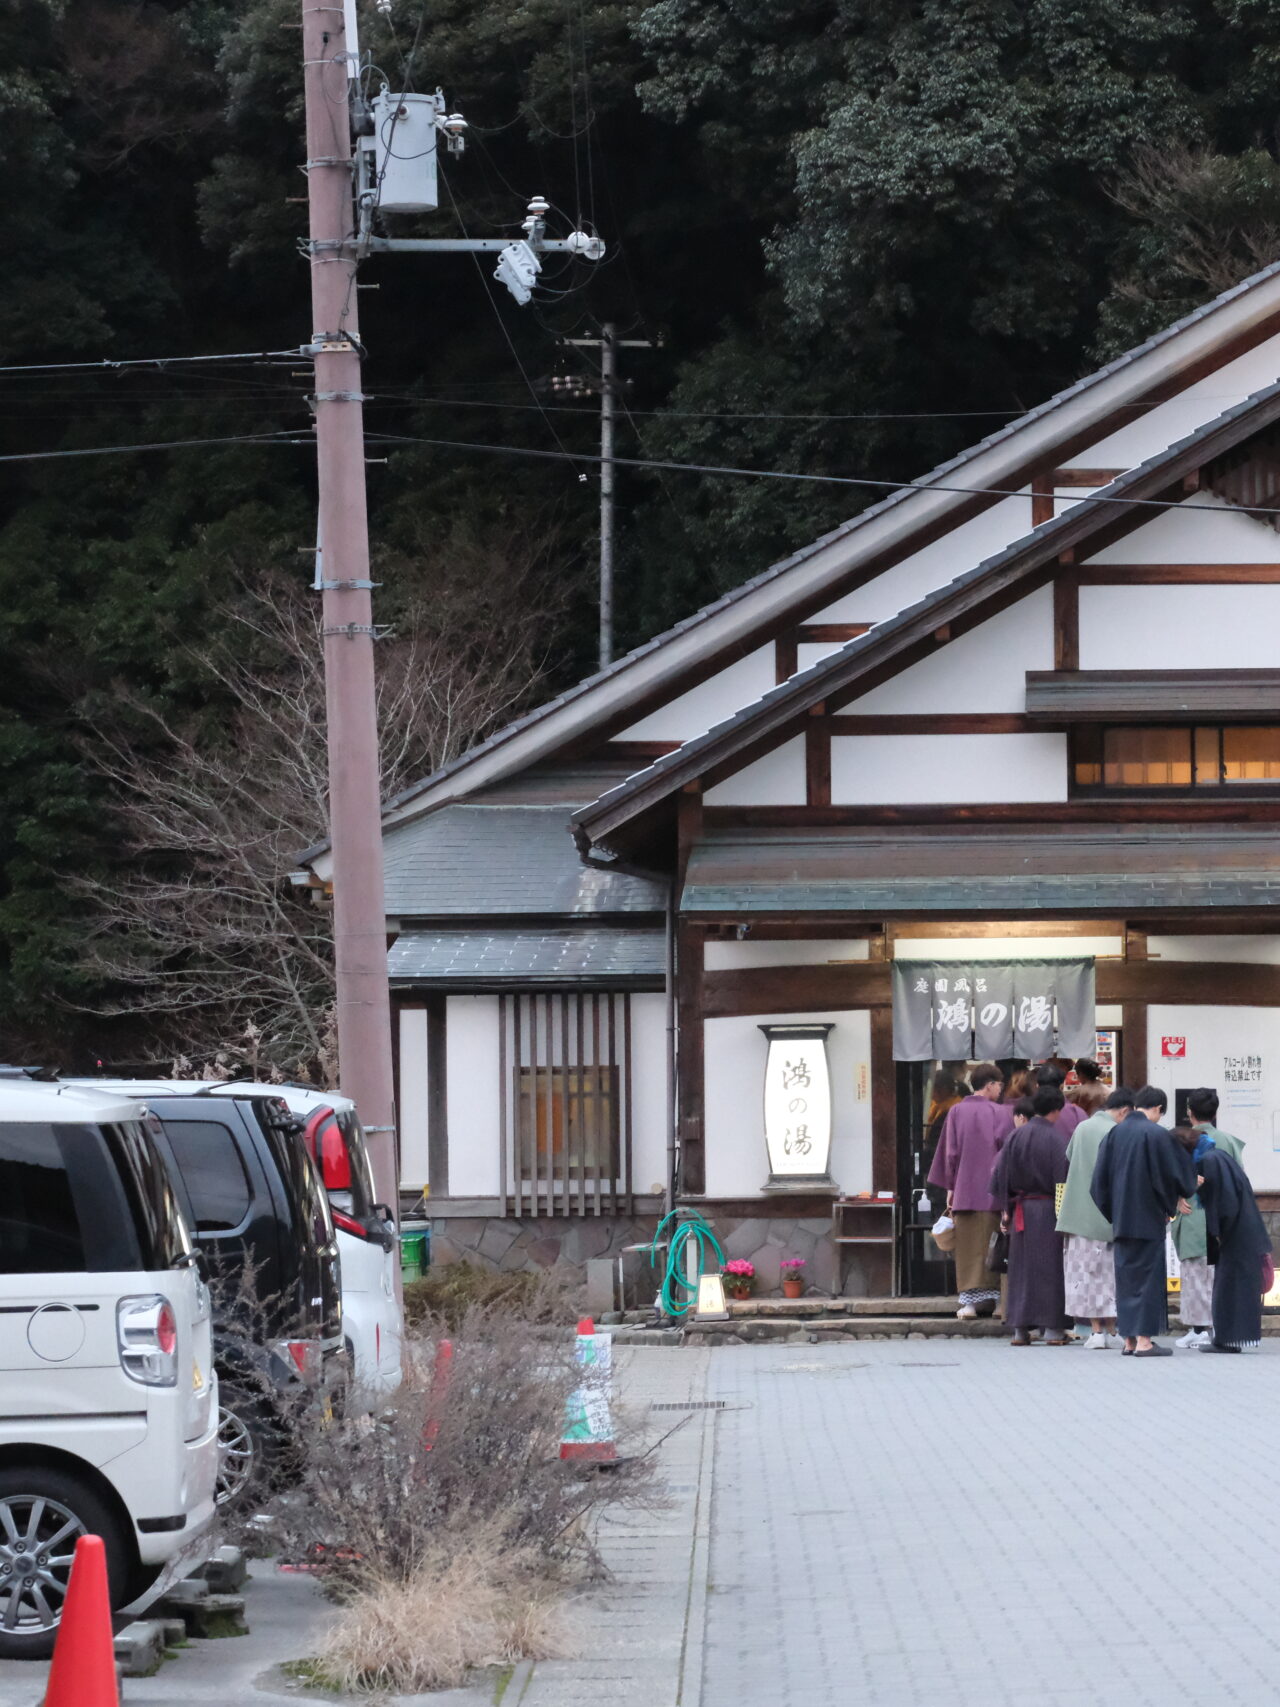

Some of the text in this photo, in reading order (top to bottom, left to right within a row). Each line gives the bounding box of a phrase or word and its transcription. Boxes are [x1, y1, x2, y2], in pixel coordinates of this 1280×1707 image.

[936, 996, 1051, 1033] 鴻の湯
[1224, 1070, 1262, 1082] 持込禁止です
[782, 1057, 813, 1156] 鴻の湯
